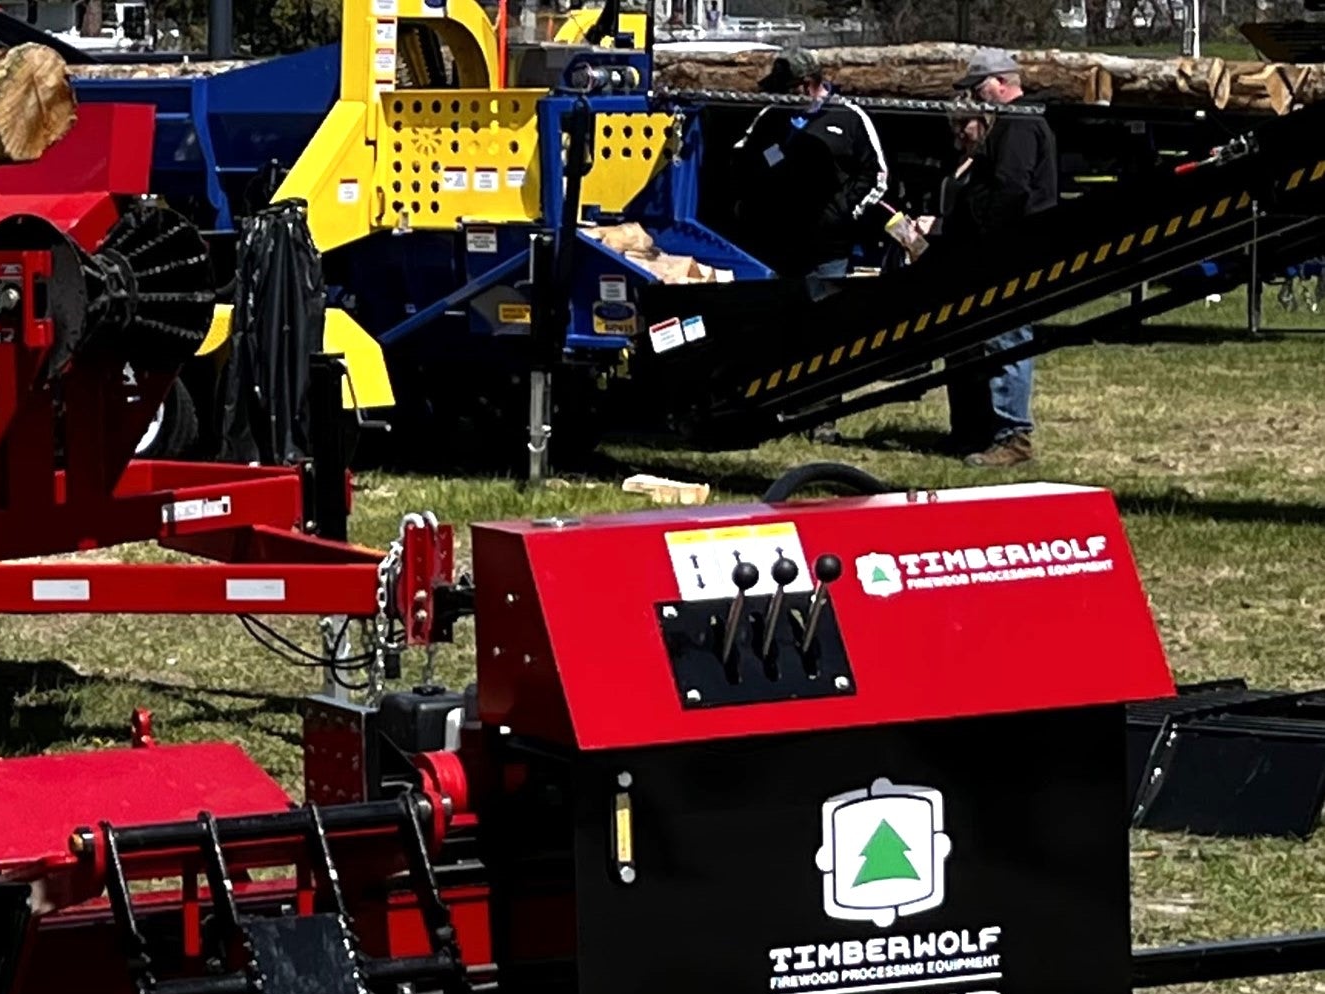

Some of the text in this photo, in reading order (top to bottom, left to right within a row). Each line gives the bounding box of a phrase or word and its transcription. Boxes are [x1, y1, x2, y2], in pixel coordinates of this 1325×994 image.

[898, 535, 1106, 575] TIMBERWOLF
[769, 926, 1002, 972] TIMBERWOLF
[770, 954, 1001, 989] FIREWOOD PROCESSING EQUIPMENT
